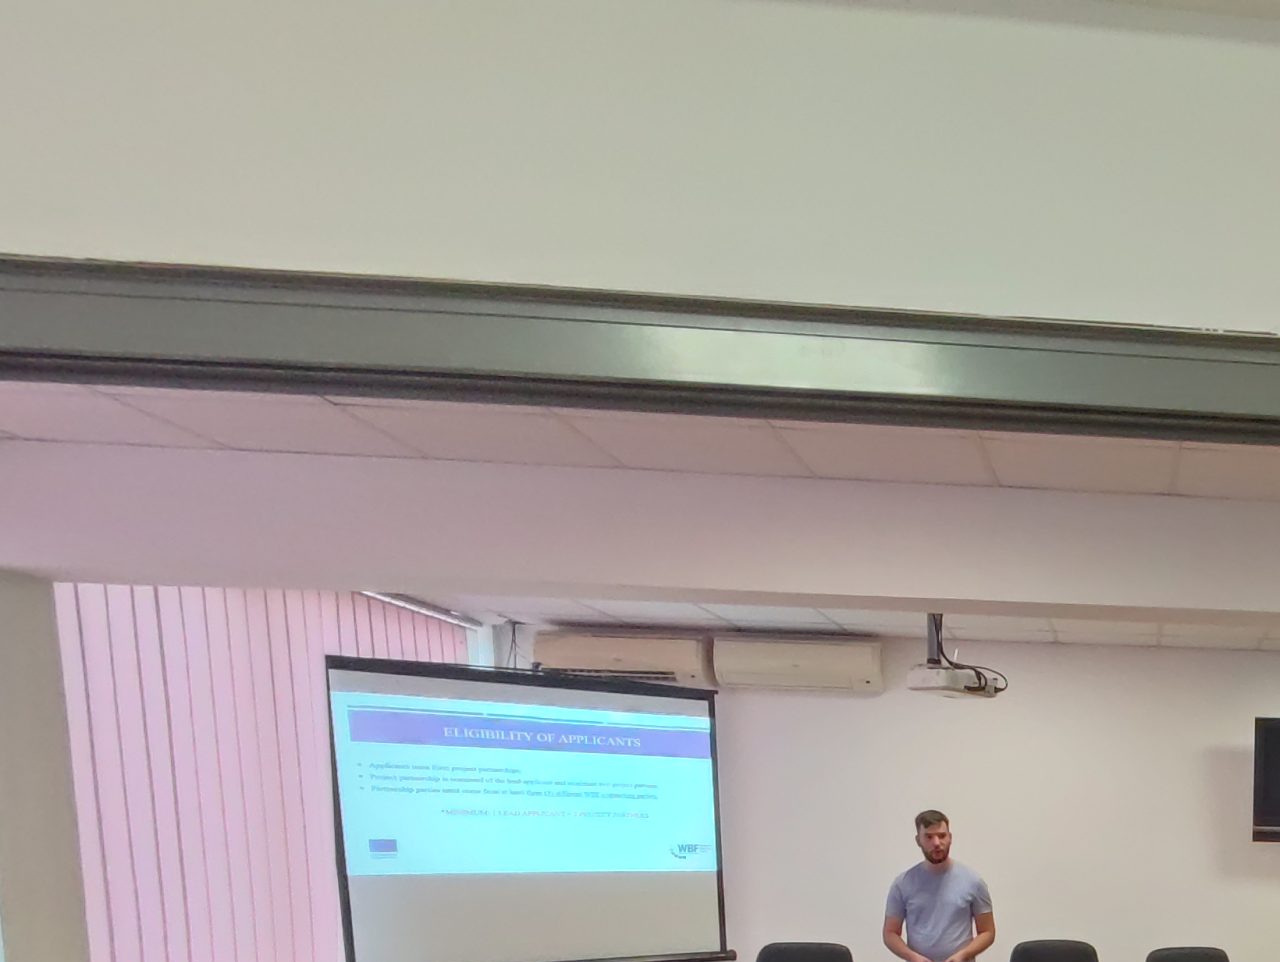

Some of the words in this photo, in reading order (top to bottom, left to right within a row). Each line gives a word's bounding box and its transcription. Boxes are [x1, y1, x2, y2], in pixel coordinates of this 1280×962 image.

[443, 727, 533, 741] ELIGIBILITY
[537, 732, 555, 743] OF
[559, 734, 640, 747] APPLICANTS
[677, 843, 698, 853] WBF
